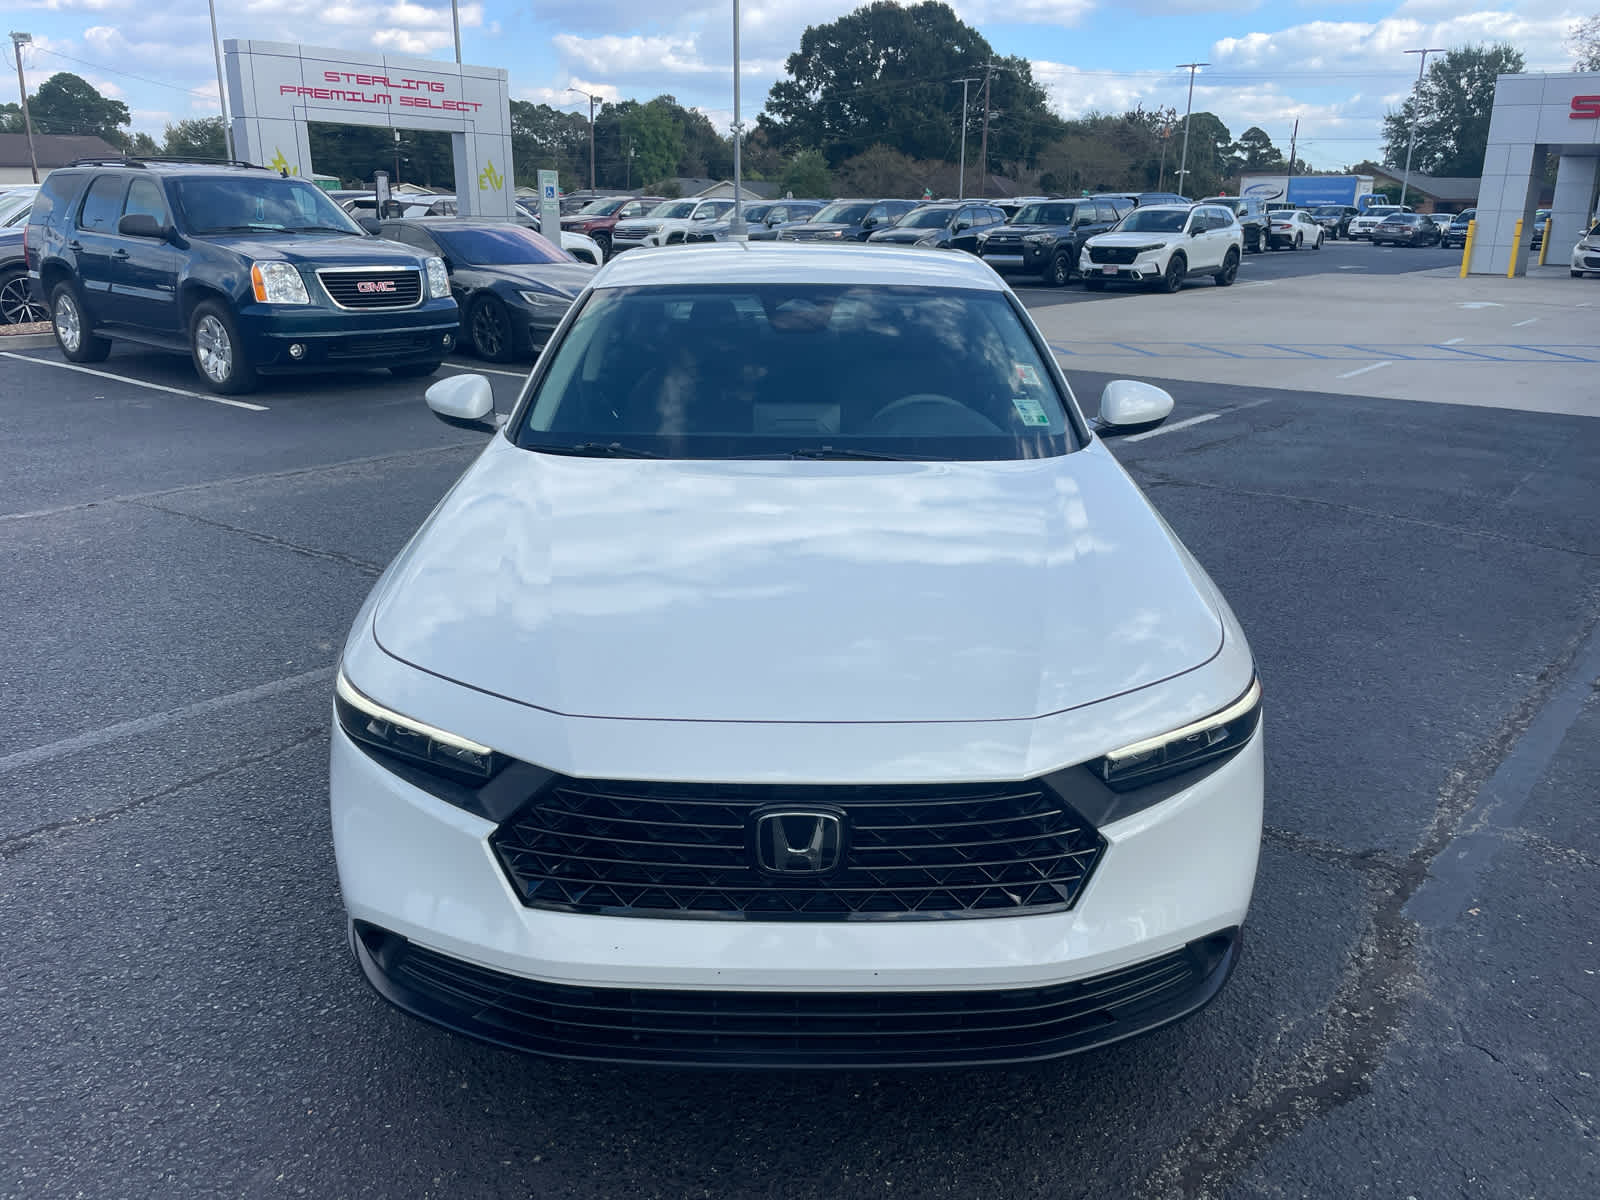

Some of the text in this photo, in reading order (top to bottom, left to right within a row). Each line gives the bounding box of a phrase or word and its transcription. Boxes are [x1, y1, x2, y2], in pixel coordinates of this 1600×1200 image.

[324, 71, 445, 93] STERLING
[279, 85, 483, 113] PREMIUM SELECT
[479, 167, 504, 191] EV
[357, 281, 396, 293] GMC
